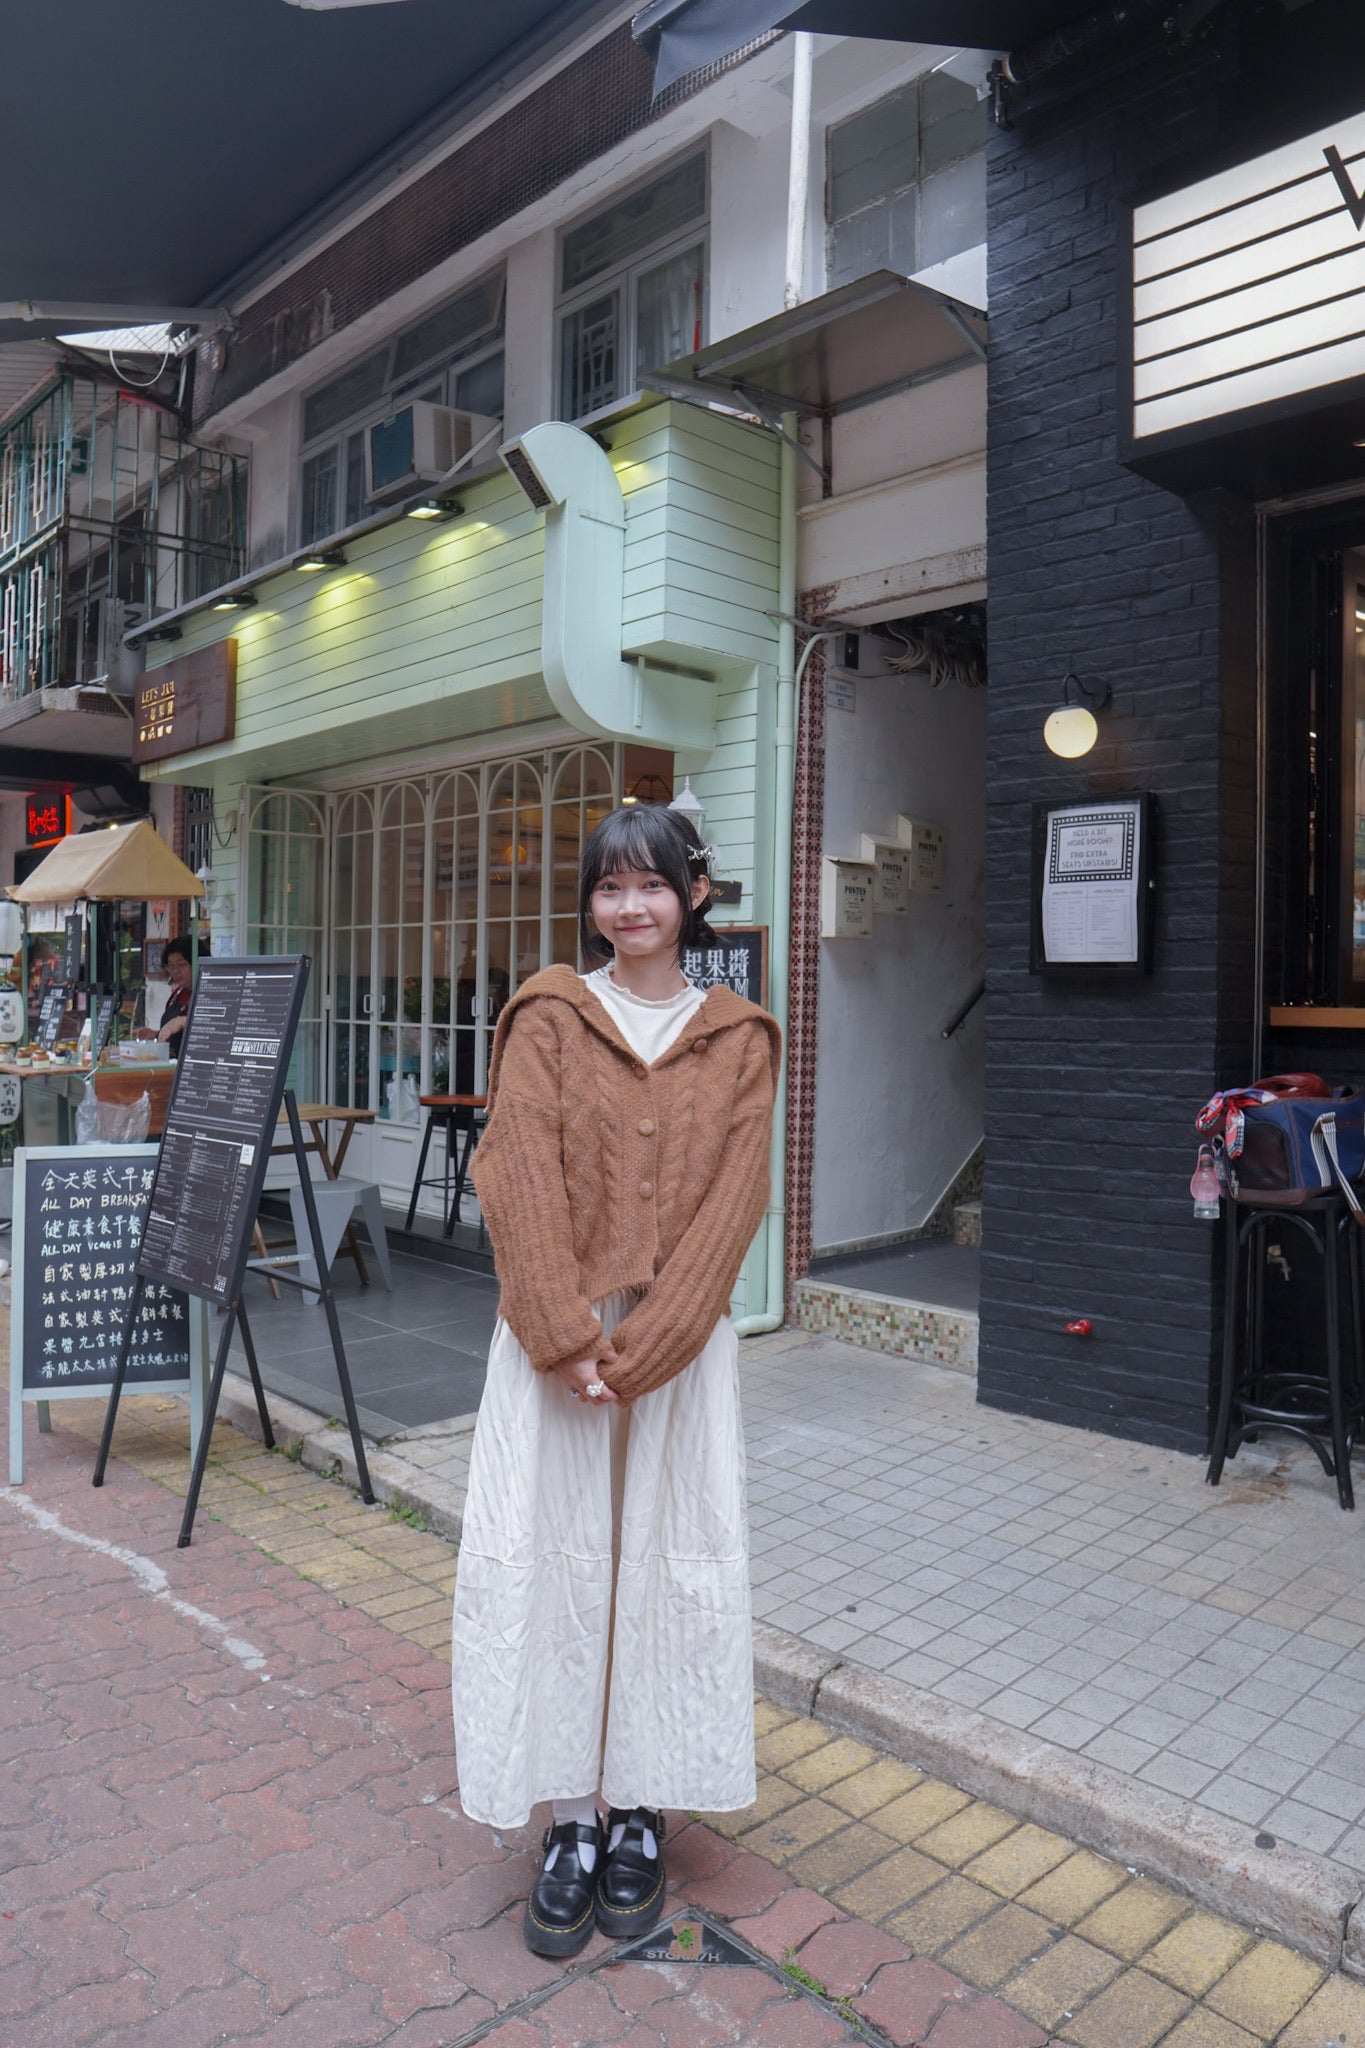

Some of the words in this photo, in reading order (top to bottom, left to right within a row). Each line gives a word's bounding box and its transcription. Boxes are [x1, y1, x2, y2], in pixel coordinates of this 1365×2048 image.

[40, 1196, 61, 1212] ALL
[69, 1197, 92, 1209] DAY
[101, 1193, 150, 1208] BREAKFA
[41, 1244, 60, 1257] ALL
[62, 1243, 81, 1254] DAY
